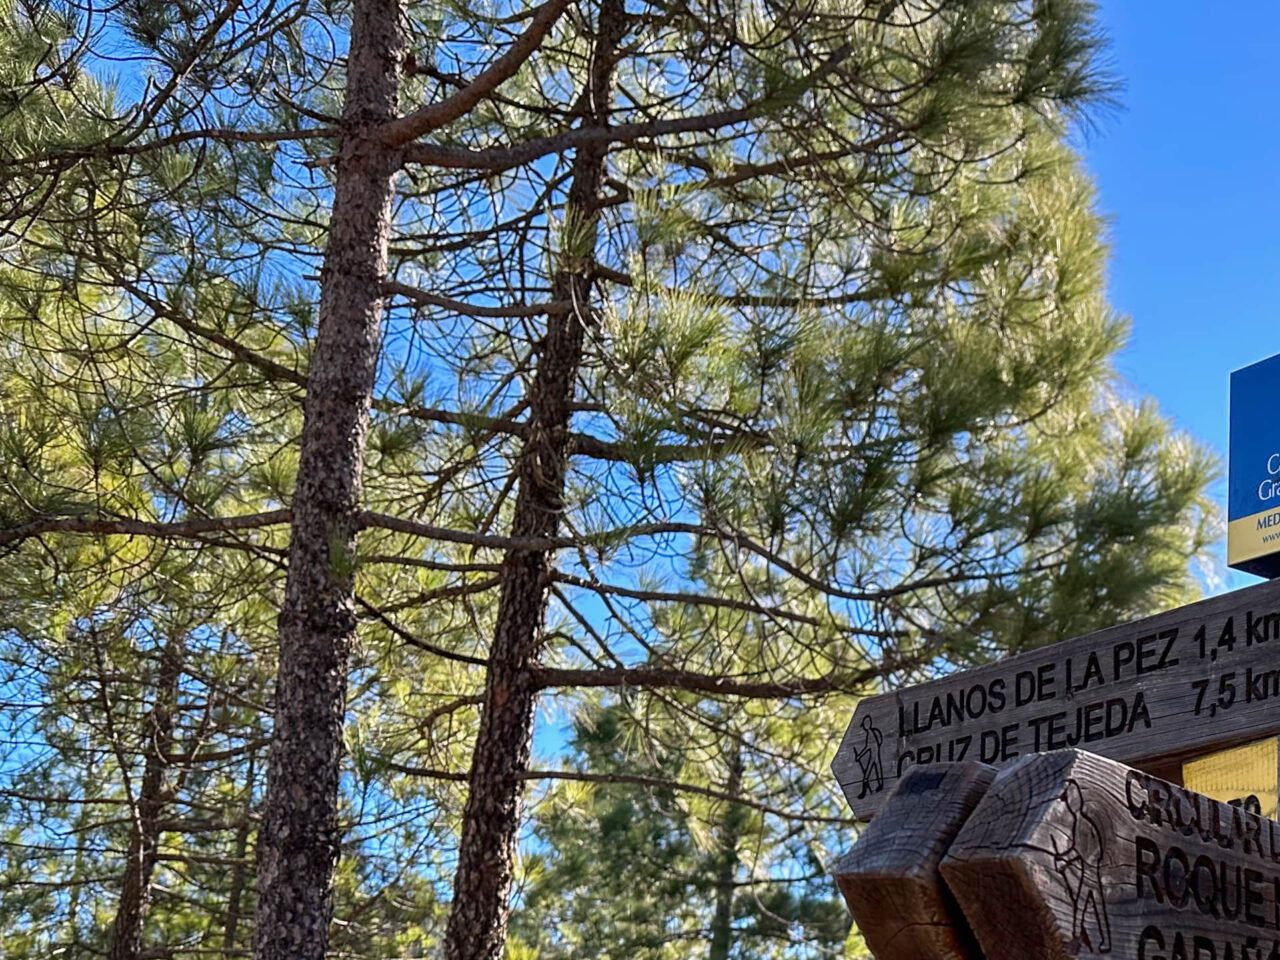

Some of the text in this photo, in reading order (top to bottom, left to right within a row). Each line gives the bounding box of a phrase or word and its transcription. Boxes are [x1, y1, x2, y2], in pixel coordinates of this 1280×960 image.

[898, 678, 1006, 738] LLANOS
[1015, 662, 1056, 708] DE
[1065, 651, 1105, 696] LA
[1113, 627, 1180, 682] PEZ
[1193, 615, 1237, 662] 1,4
[979, 722, 1020, 765] DE
[1028, 691, 1152, 752] TEJEDA
[1191, 671, 1237, 718] 7,5
[1135, 835, 1266, 927] ROQUE
